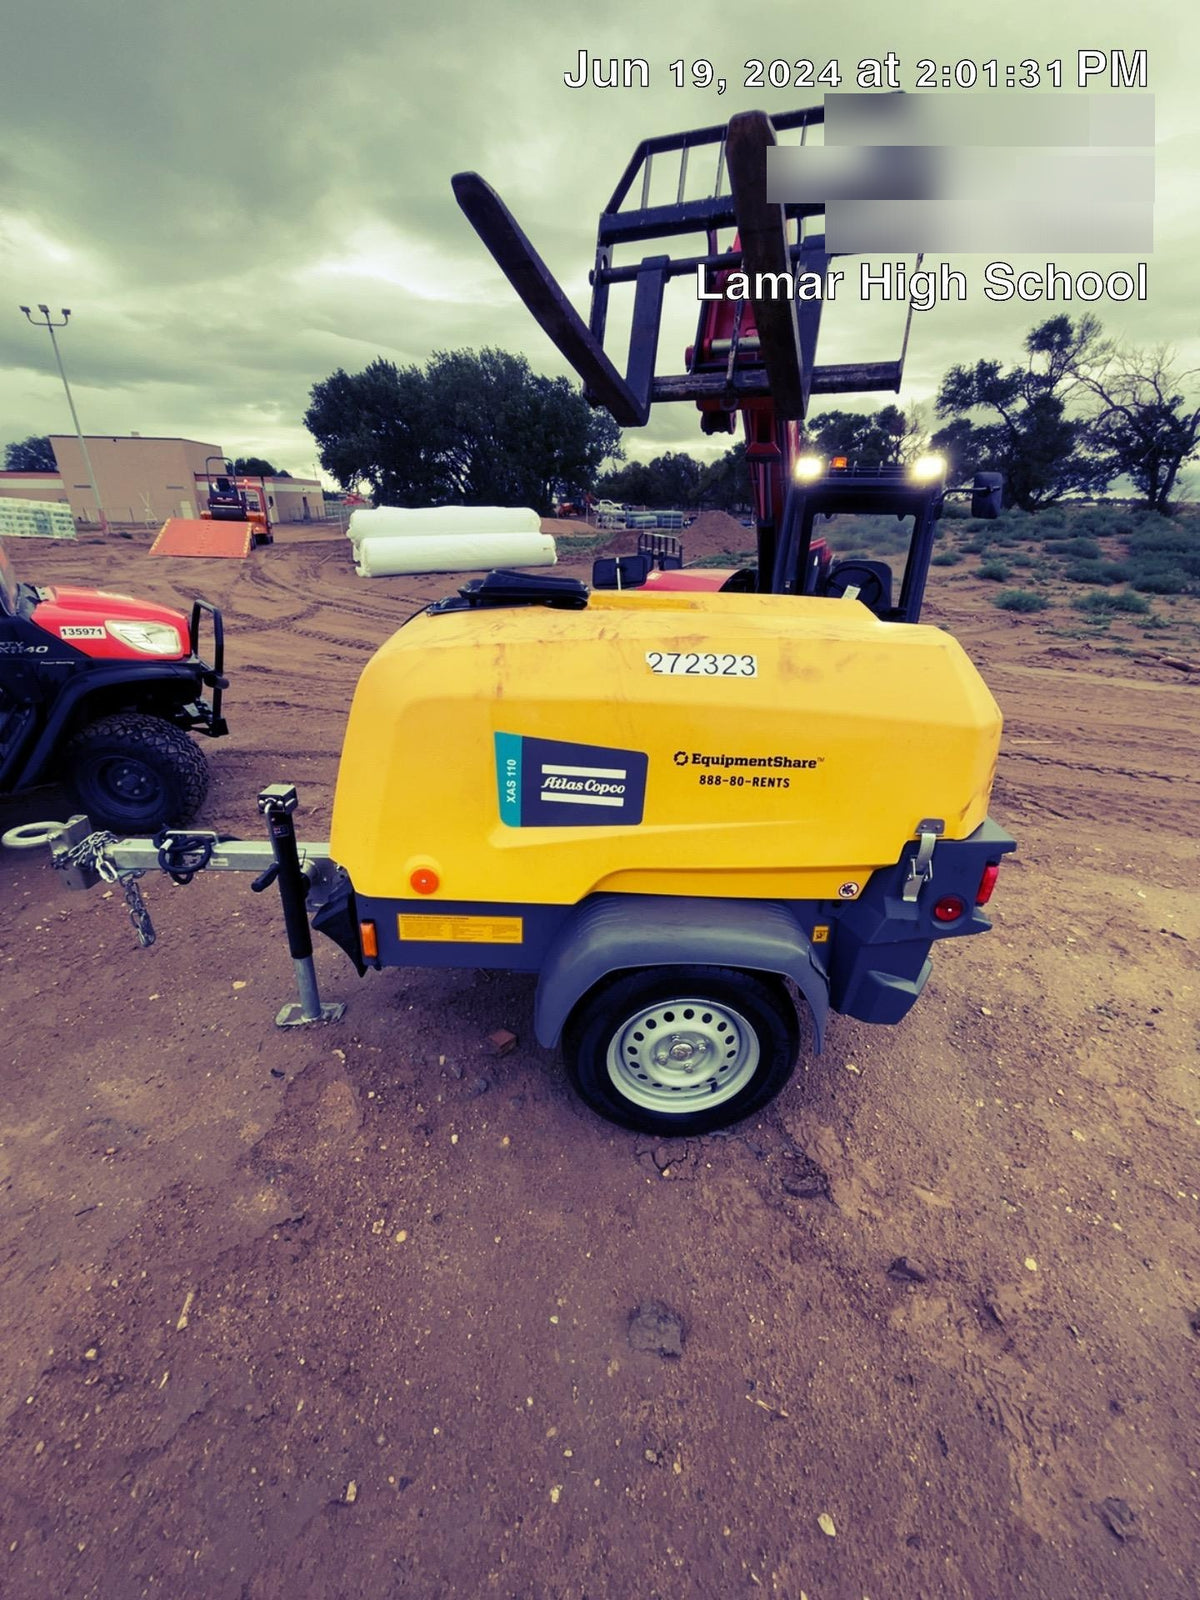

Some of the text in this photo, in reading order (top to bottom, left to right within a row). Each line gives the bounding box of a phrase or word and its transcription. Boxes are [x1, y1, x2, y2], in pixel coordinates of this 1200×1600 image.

[61, 628, 103, 636] 135971
[648, 652, 757, 677] 272323
[506, 759, 517, 804] XAS 110
[541, 776, 626, 796] Atlas Copco
[699, 775, 791, 789] 888-80-RENTS
